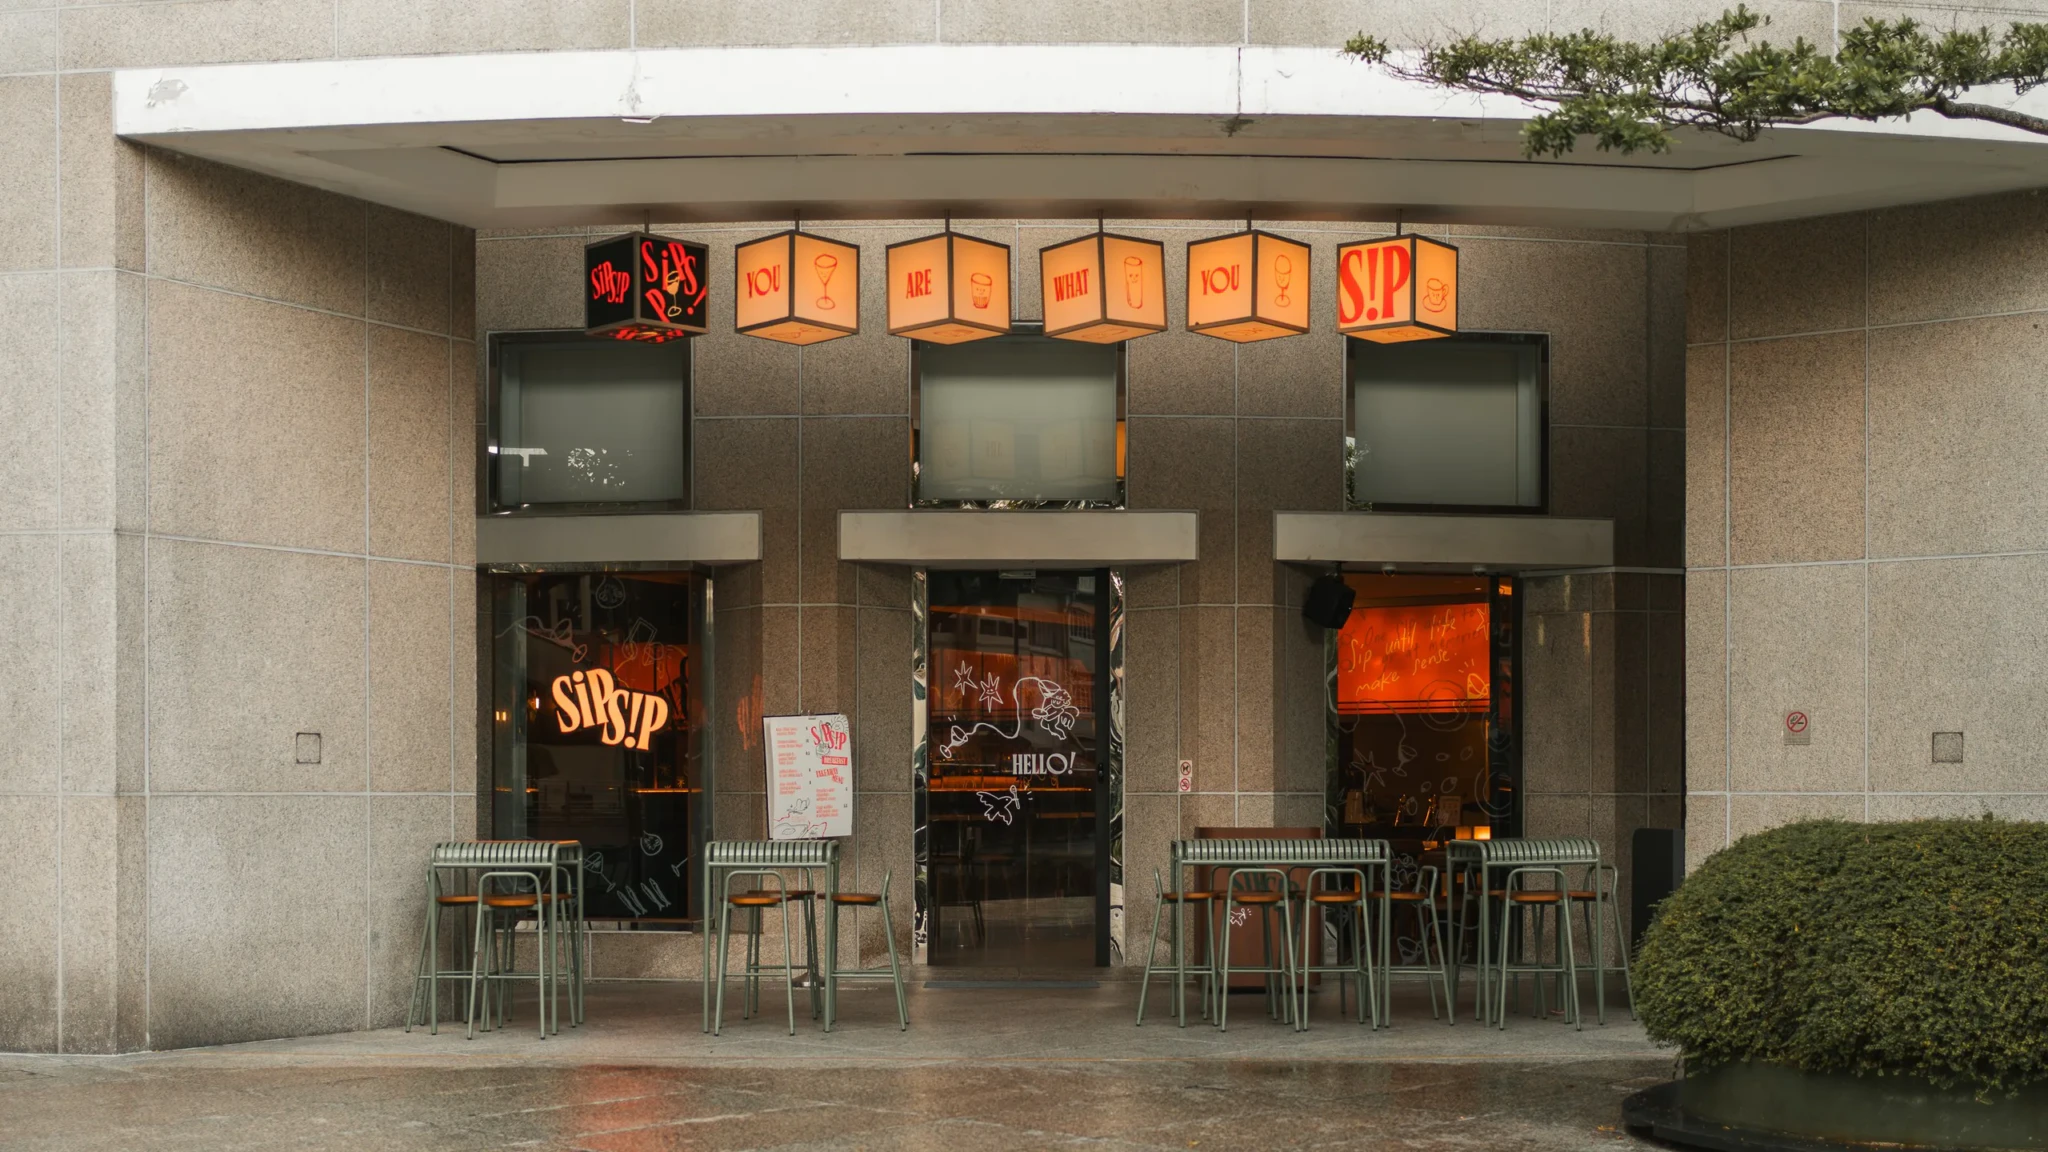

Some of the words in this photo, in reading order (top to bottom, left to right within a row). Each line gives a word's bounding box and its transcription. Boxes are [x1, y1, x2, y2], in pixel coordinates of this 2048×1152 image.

[746, 264, 780, 299] YOU
[905, 268, 932, 300] ARE
[1053, 268, 1089, 302] WHAT
[1201, 264, 1240, 296] YOU
[1348, 638, 1372, 673] Sip
[1386, 622, 1416, 654] until
[1430, 608, 1456, 640] life
[1356, 671, 1400, 696] make
[1012, 751, 1076, 775] HELLO!
